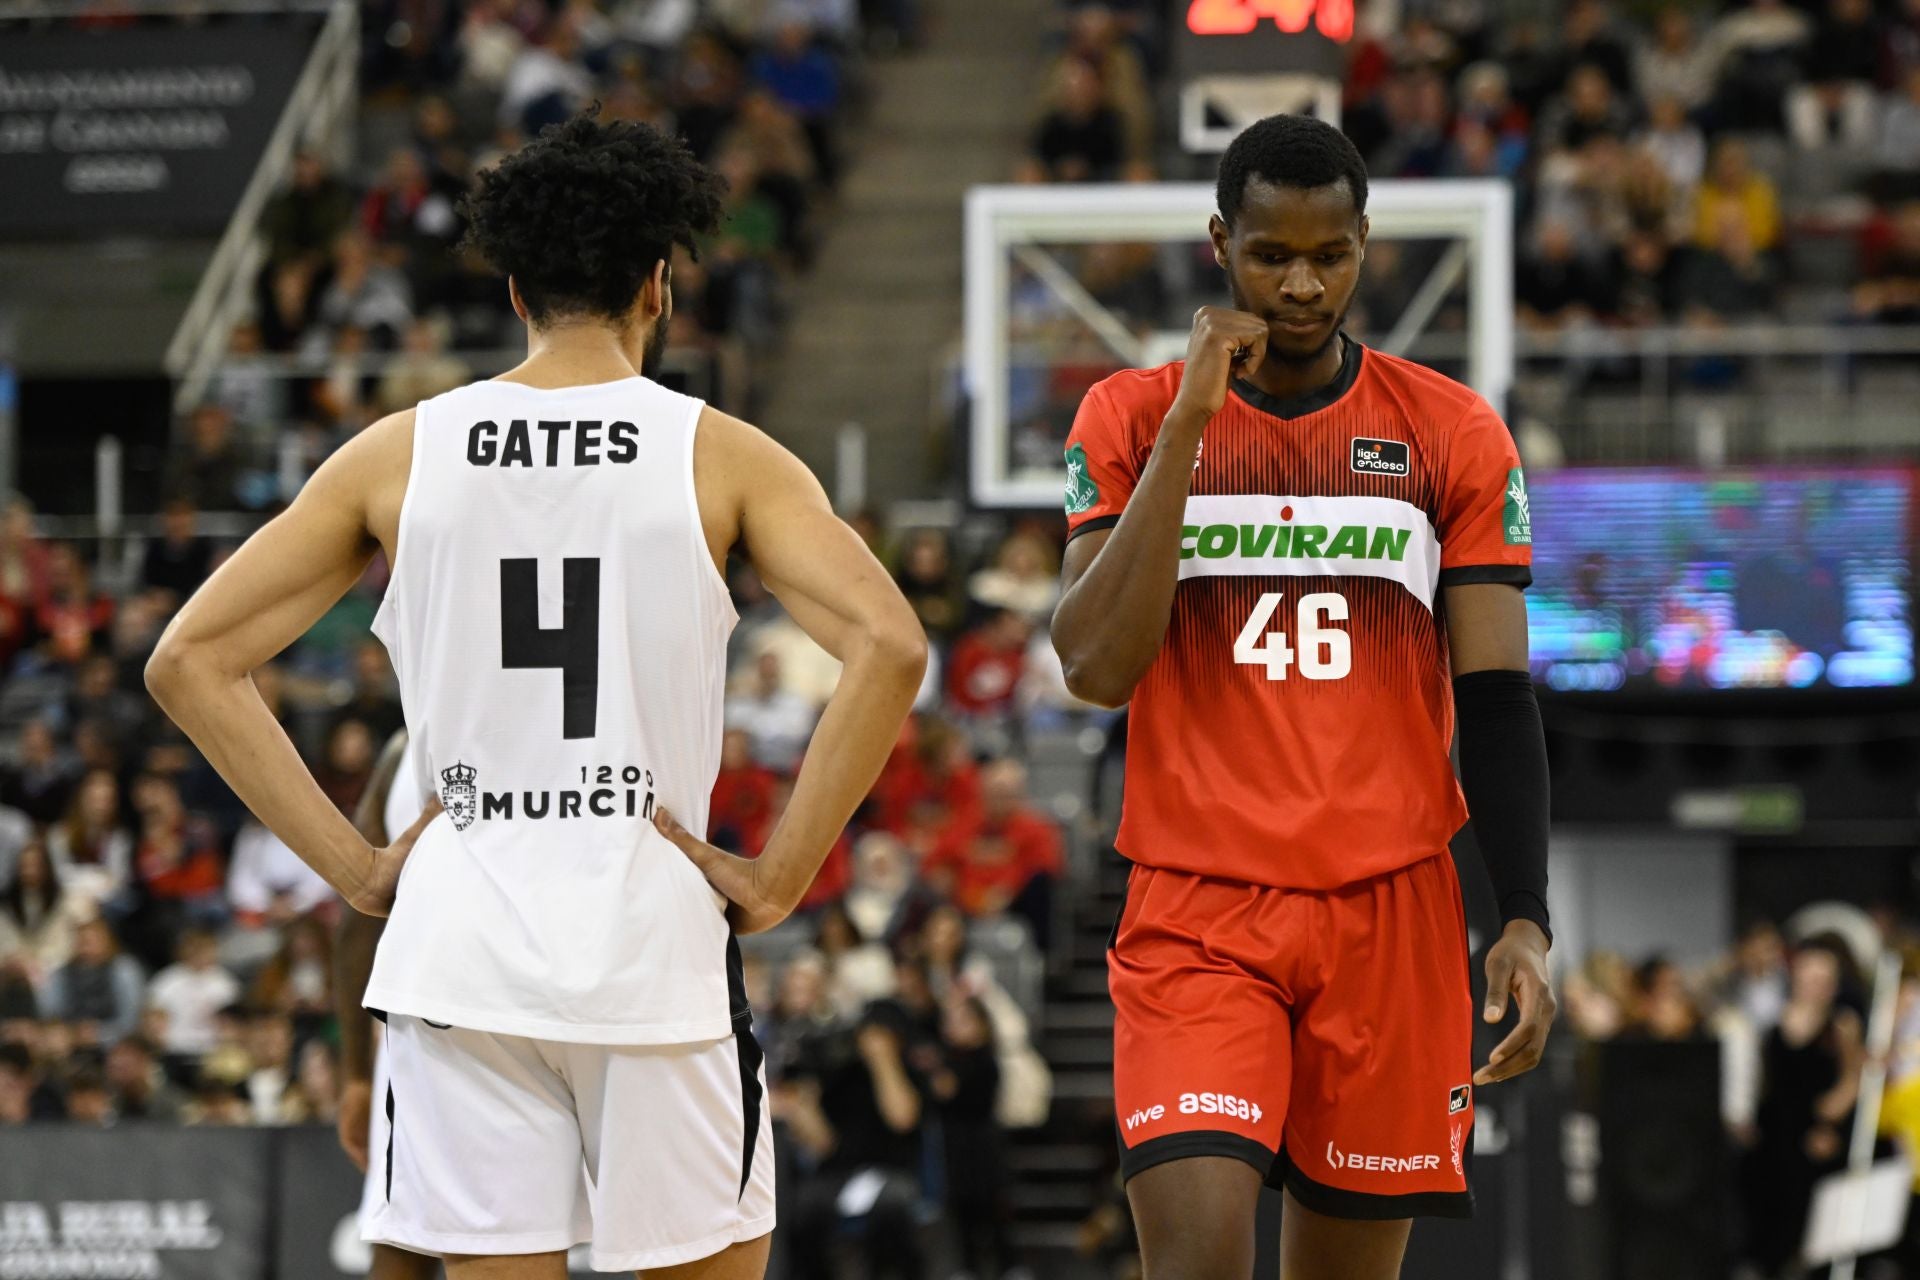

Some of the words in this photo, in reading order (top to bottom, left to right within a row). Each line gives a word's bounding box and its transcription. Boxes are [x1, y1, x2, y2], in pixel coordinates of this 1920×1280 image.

[467, 420, 639, 467] GATES
[1357, 448, 1379, 460] liga
[1357, 460, 1404, 471] endesa
[500, 557, 600, 740] 4
[1233, 592, 1352, 681] 46
[1125, 1104, 1165, 1130] vive
[1348, 1153, 1440, 1173] BERNER
